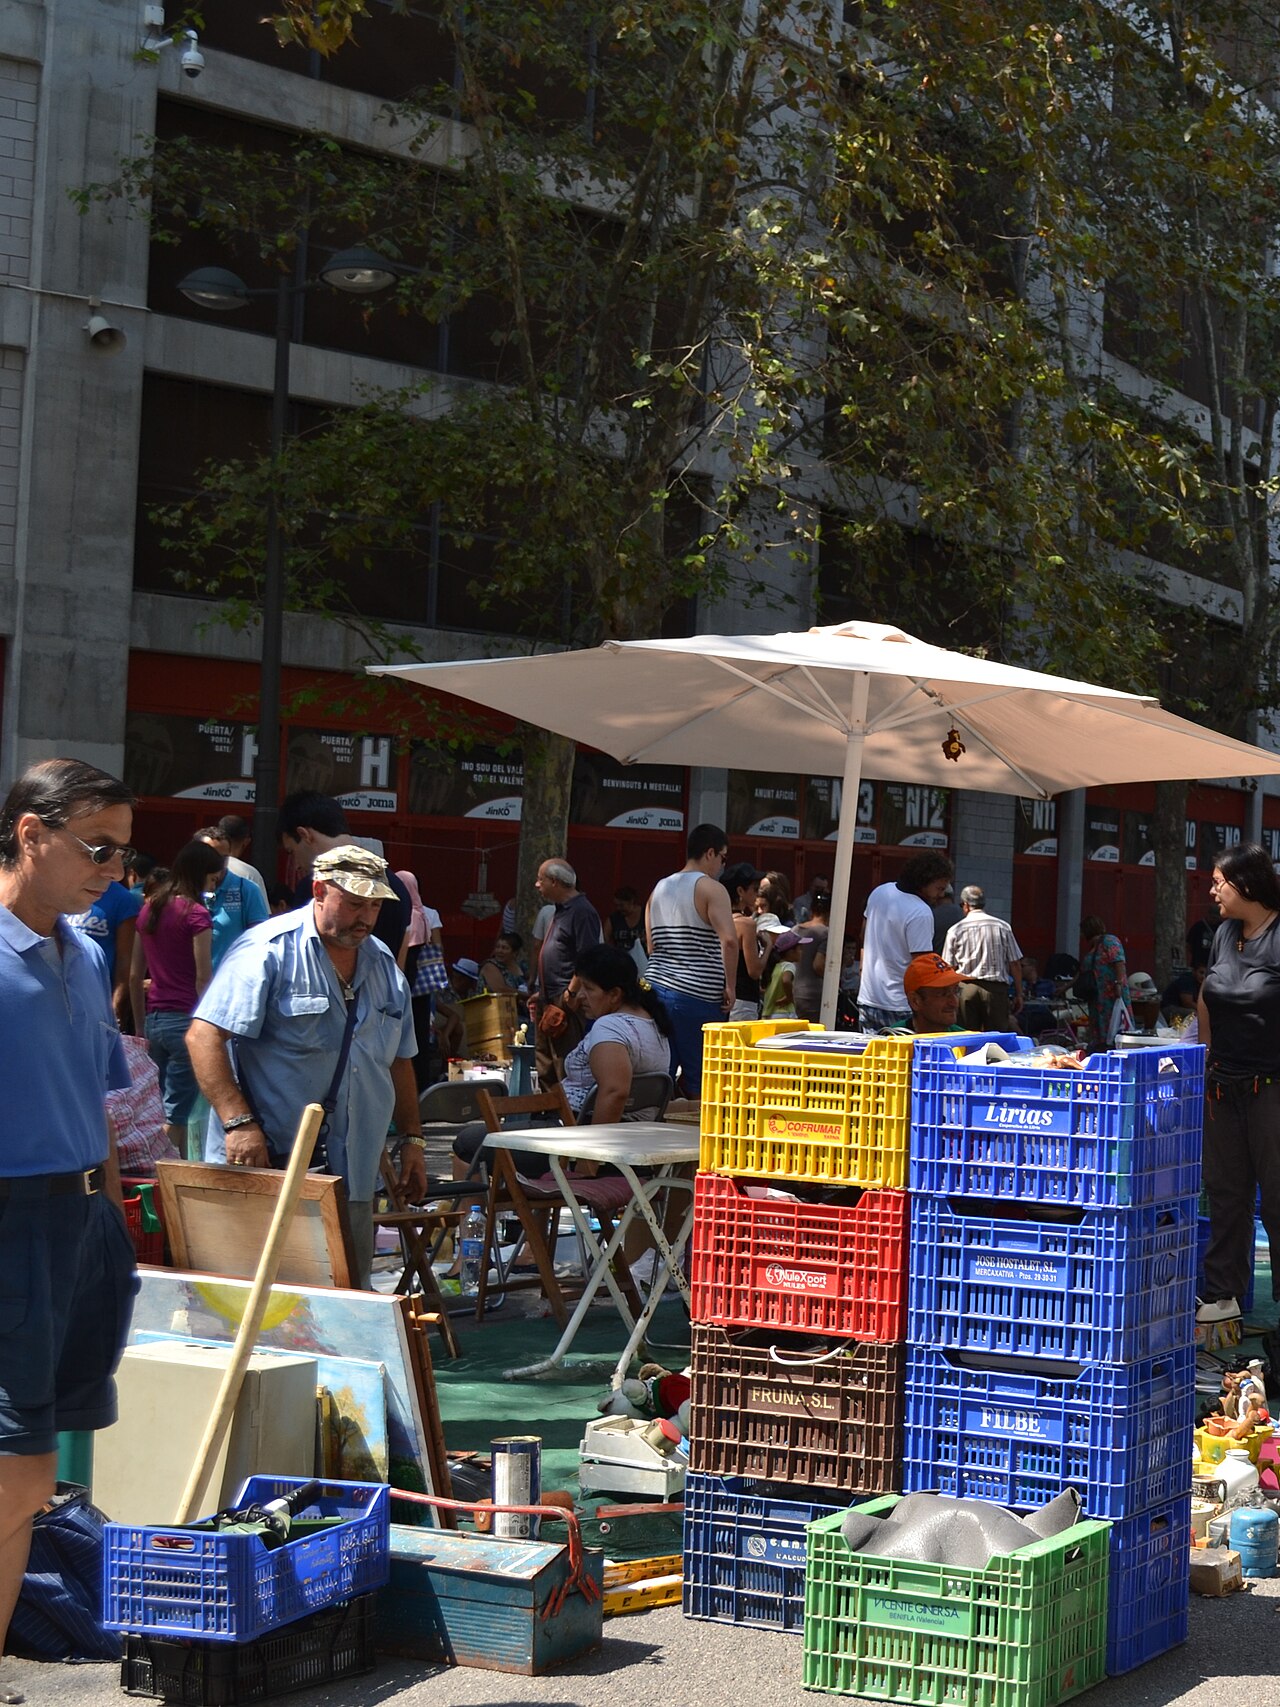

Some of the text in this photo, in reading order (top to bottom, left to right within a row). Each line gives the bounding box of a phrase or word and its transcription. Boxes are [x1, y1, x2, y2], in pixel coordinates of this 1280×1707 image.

[320, 735, 354, 747] PUERTA/
[360, 736, 391, 788] H
[603, 779, 682, 793] BENVINGUTS A MESTALLA!
[831, 779, 874, 824] N3
[905, 786, 944, 829] N12
[1033, 800, 1056, 831] N11
[1185, 821, 1196, 848] 10
[984, 1101, 1054, 1126] Lirias
[787, 1122, 842, 1135] COFRUMAR
[979, 1407, 1041, 1433] FILBE
[874, 1597, 914, 1613] VICENTE
